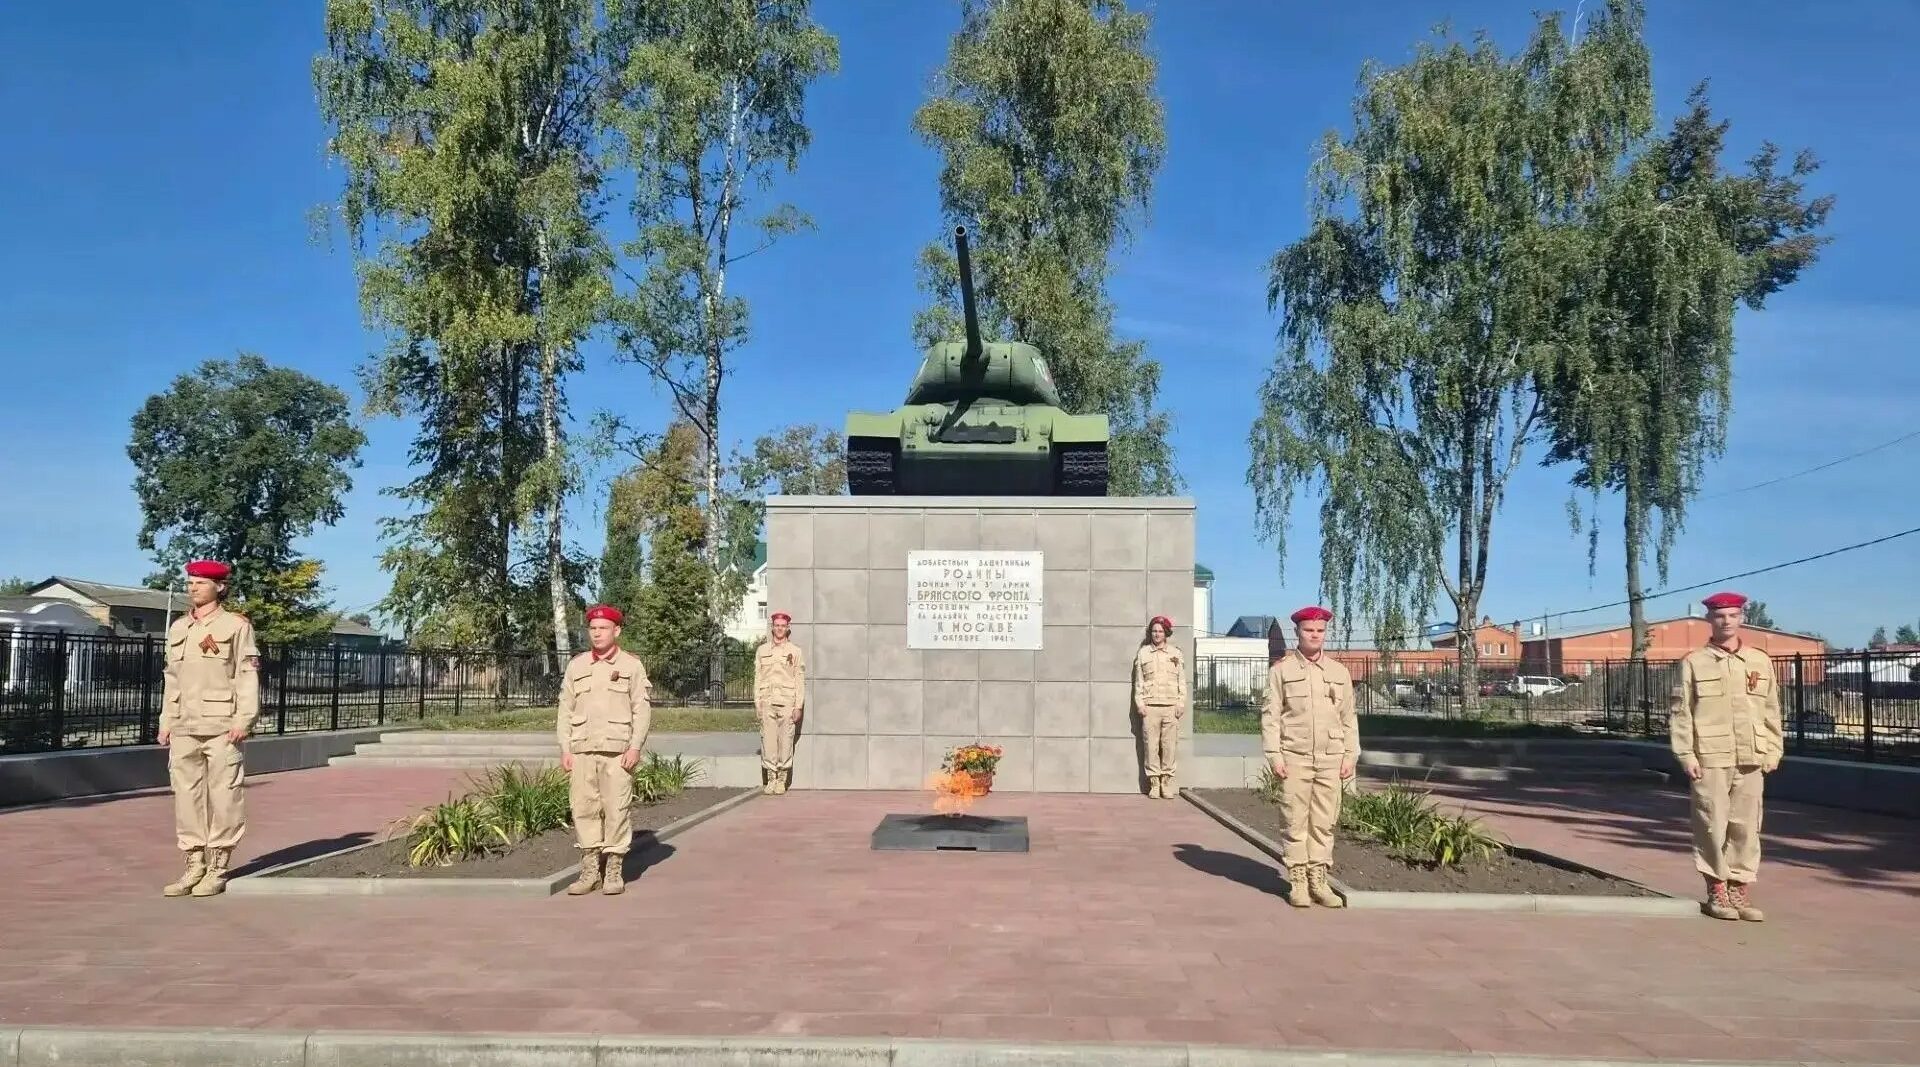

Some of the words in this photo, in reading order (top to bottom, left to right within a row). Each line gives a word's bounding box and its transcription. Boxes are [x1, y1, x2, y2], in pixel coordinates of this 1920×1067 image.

[979, 559, 1031, 567] ЗАЩИТНИКАМ
[943, 568, 1005, 579] РОДИНЫ
[917, 590, 982, 601] БРЯНСКОГО
[988, 590, 1030, 601] ФРОНТА
[952, 622, 1013, 633] МОСКВЕ
